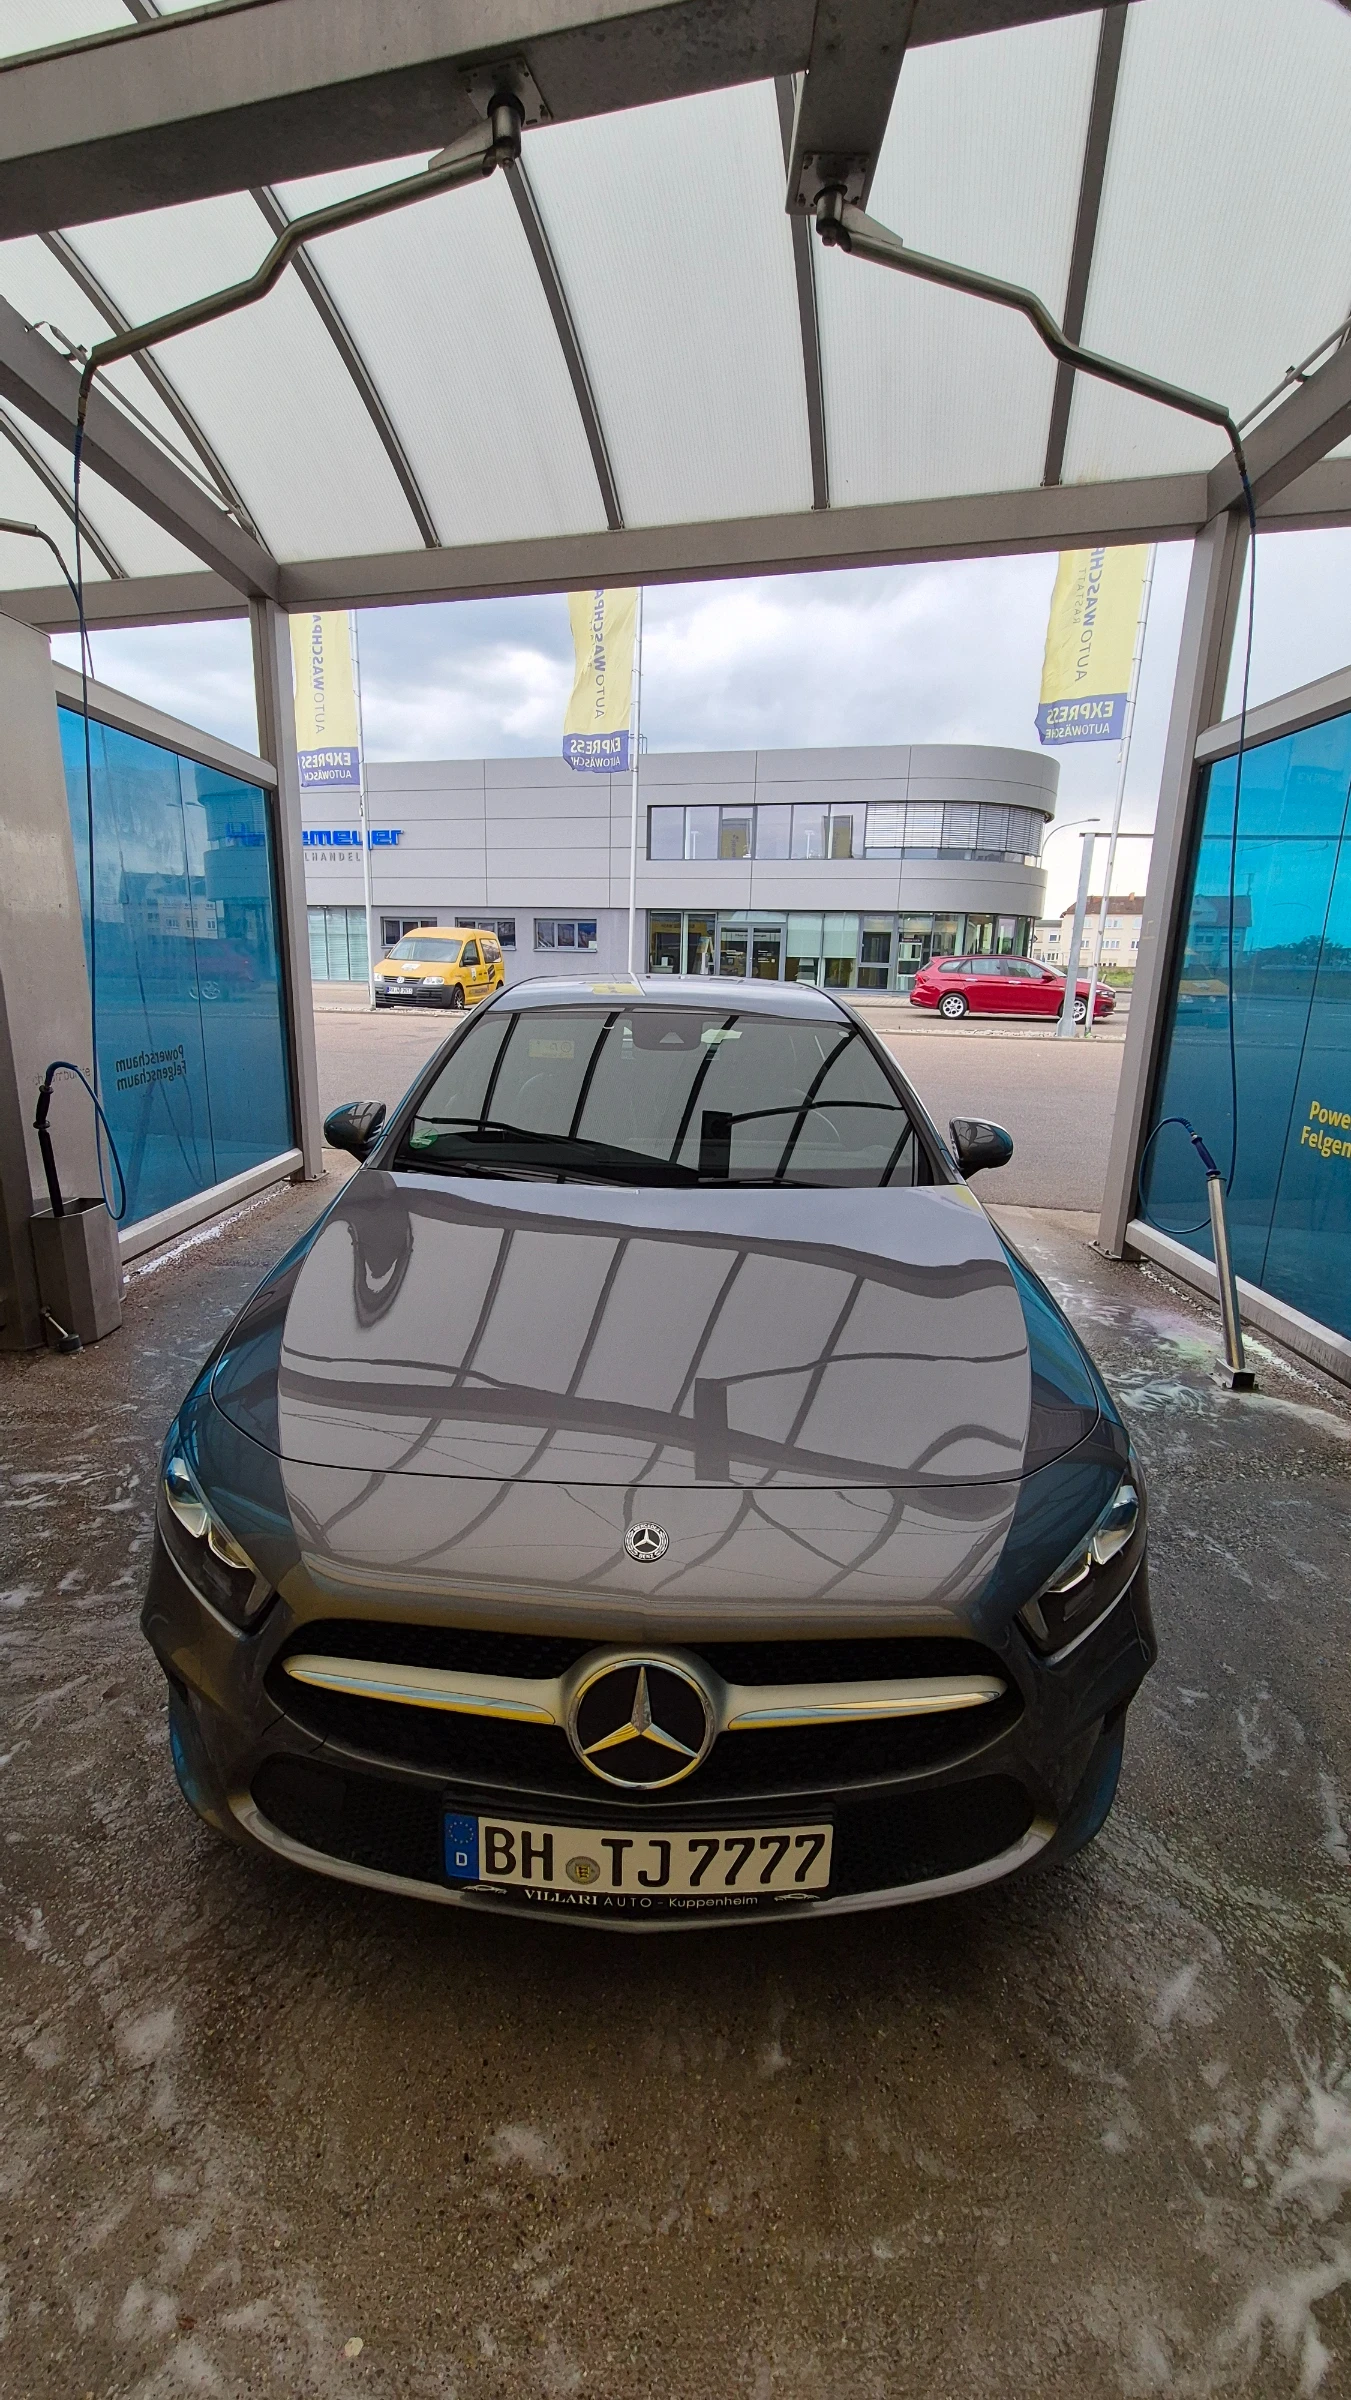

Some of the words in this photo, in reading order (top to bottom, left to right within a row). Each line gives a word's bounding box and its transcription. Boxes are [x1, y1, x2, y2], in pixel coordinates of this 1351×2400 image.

[1309, 1100, 1351, 1130] Powe
[455, 1851, 468, 1867] D
[484, 1825, 554, 1882] BH
[600, 1838, 671, 1887] TJ
[688, 1832, 826, 1887] 7777
[524, 1889, 598, 1906] VILLARI
[603, 1897, 652, 1908] AUTO
[669, 1895, 758, 1909] Kuppenheim
